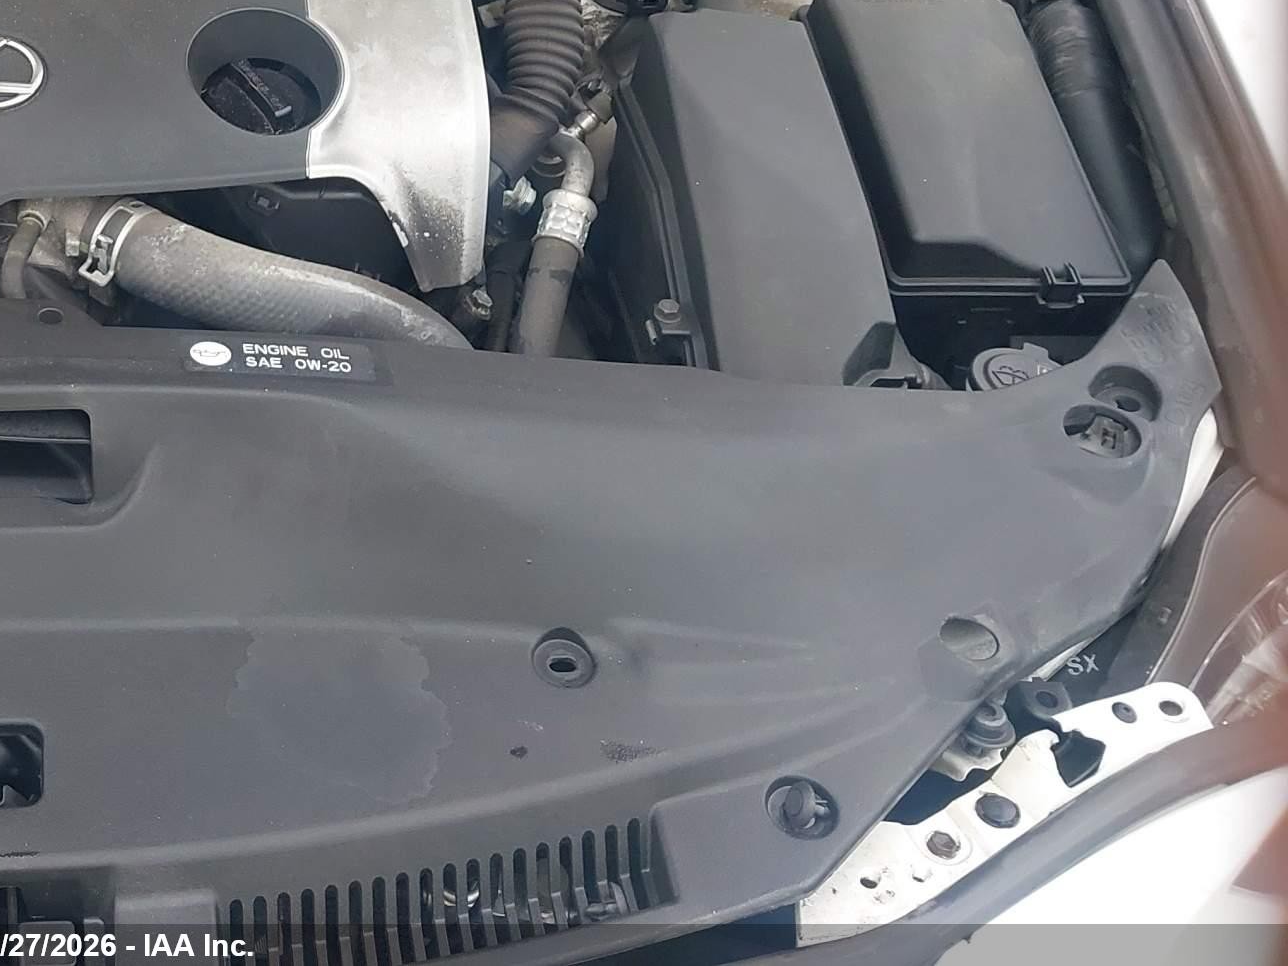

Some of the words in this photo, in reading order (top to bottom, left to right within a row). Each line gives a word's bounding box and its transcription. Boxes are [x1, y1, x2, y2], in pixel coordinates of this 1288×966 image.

[242, 343, 309, 357] ENGINE
[320, 347, 350, 359] OIL
[245, 356, 283, 369] SAE
[294, 358, 352, 373] 0W-20
[1066, 653, 1100, 676] SX
